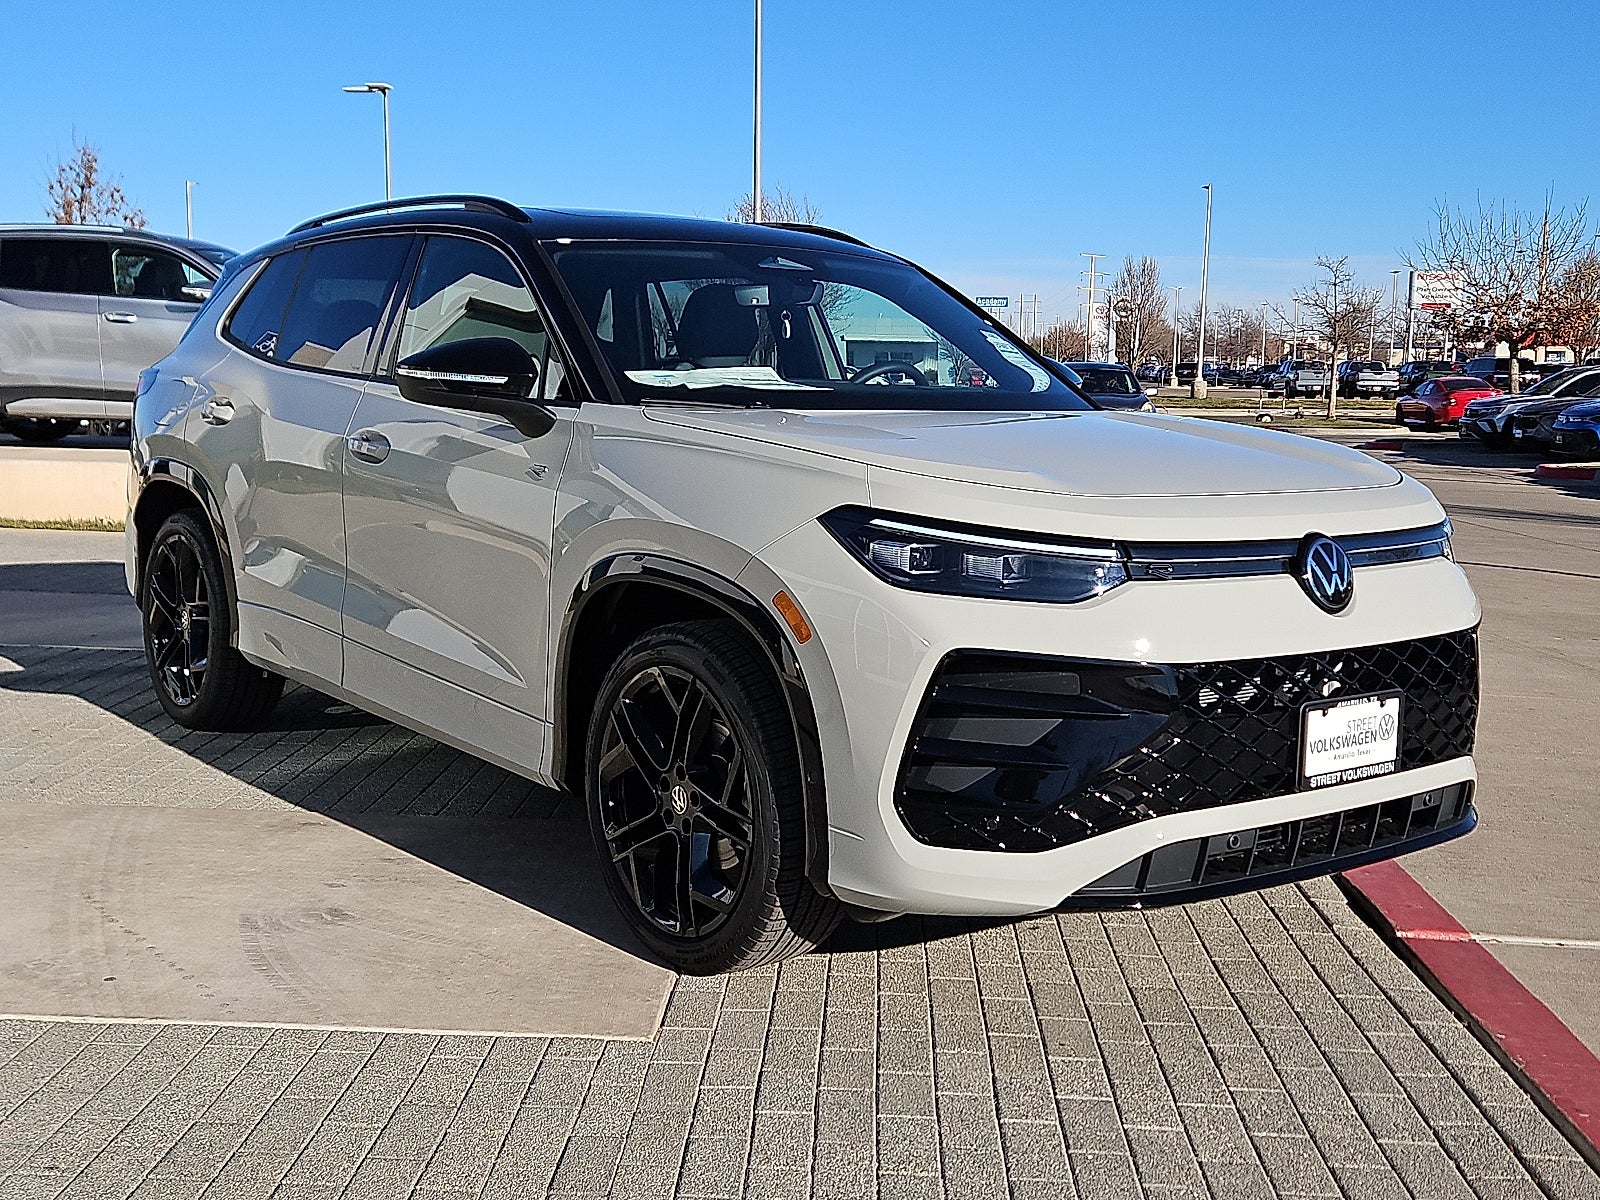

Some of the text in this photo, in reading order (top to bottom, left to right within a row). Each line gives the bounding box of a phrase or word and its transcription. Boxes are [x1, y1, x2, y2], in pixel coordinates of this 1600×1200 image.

[977, 297, 1007, 307] Academy
[1347, 716, 1377, 733] STREET
[1310, 730, 1377, 754] VOLKSWAGEN
[1310, 761, 1395, 788] STREET VOLKSWAGEN
